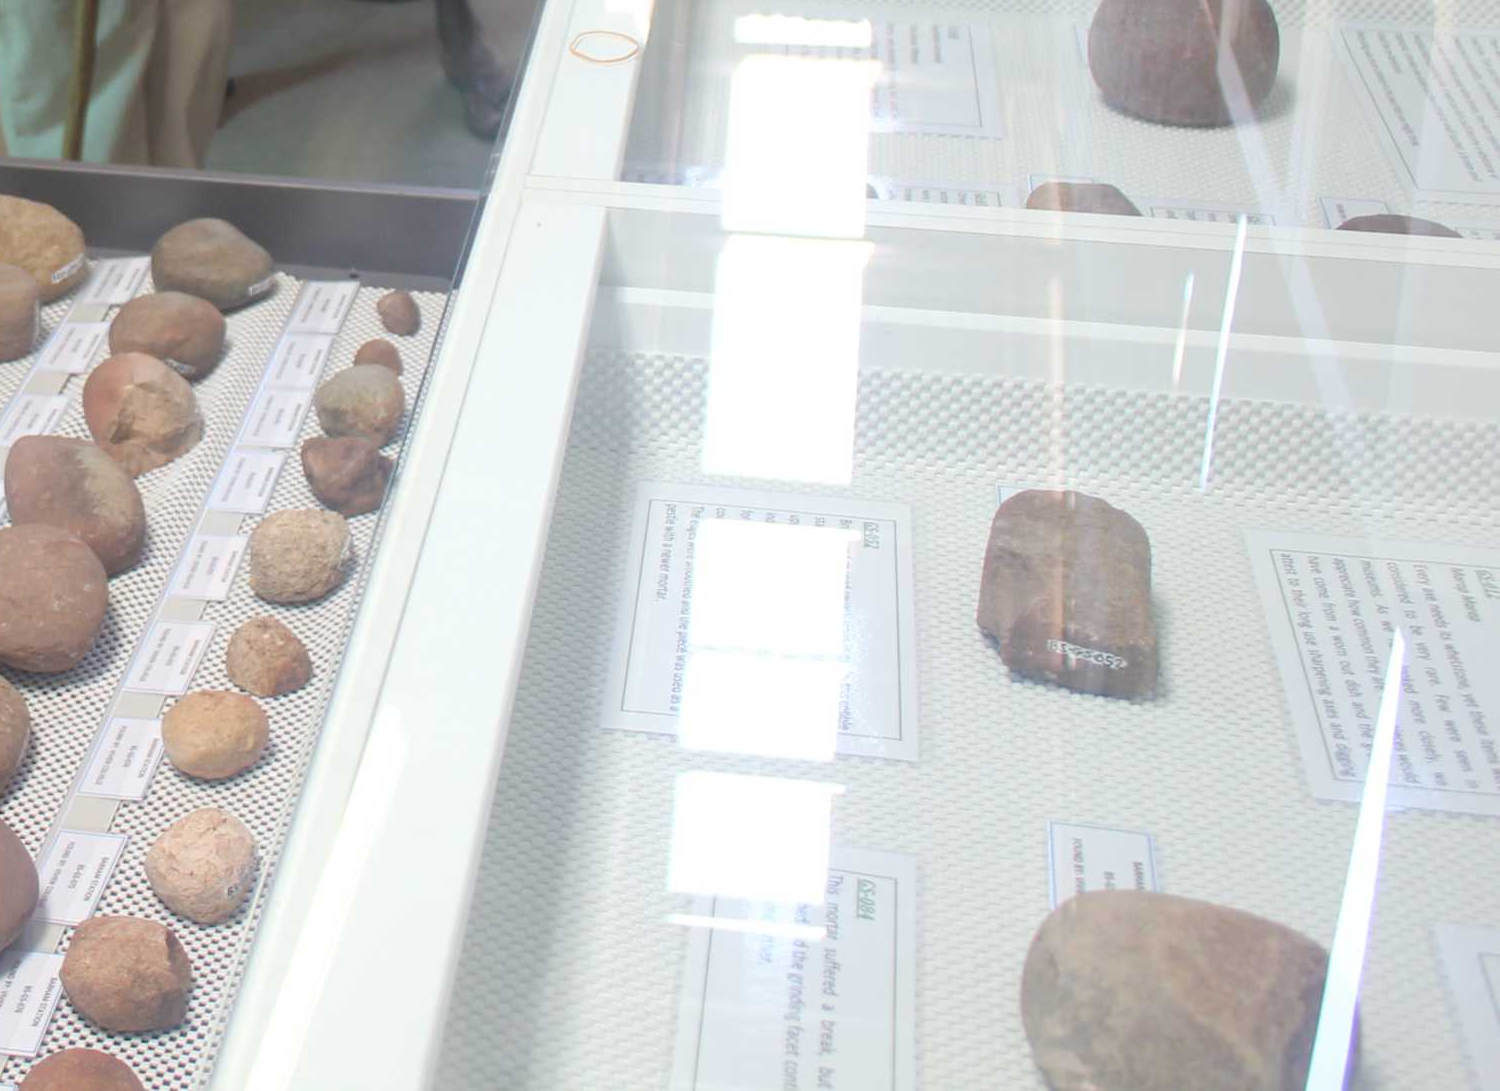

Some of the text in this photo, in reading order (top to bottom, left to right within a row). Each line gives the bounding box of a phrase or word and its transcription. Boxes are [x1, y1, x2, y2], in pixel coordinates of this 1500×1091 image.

[664, 503, 679, 525] pestle
[663, 526, 677, 542] with
[659, 548, 672, 572] newer
[1281, 553, 1298, 575] attest
[1308, 556, 1322, 573] have
[1288, 578, 1300, 586] to
[1314, 576, 1329, 598] come
[1334, 559, 1355, 596] appreciate
[1389, 563, 1412, 603] considered
[1290, 588, 1308, 607] their
[1348, 599, 1362, 616] how
[1295, 610, 1313, 628] long
[1322, 602, 1340, 621] from
[1404, 609, 1417, 619] to
[1303, 630, 1317, 645] use
[1354, 618, 1373, 653] common
[1410, 625, 1425, 635] be
[675, 631, 689, 653] piece
[1330, 634, 1346, 655] worn
[1414, 641, 1430, 660] very
[674, 655, 686, 672] was
[1307, 650, 1332, 695] sharpening
[1339, 660, 1354, 675] out
[1364, 655, 1382, 674] they
[1376, 604, 1389, 614] As
[1408, 700, 1427, 723] more
[1429, 604, 1448, 628] needs
[1460, 692, 1477, 707] yet
[1470, 711, 1490, 735] these
[1345, 679, 1363, 698] dish
[1352, 701, 1370, 719] and
[1434, 694, 1452, 712] Few
[1329, 722, 1347, 740] and
[1358, 723, 1374, 737] the
[1443, 719, 1461, 742] were
[1398, 755, 1416, 782] would
[1454, 749, 1472, 771] seen
[60, 841, 76, 858] FOUND
[83, 857, 108, 900] BARHAM STATION
[828, 872, 843, 896] This
[825, 902, 839, 939] mortar
[791, 950, 808, 969] the
[822, 949, 841, 995] suffered
[31, 978, 57, 1027] BARHAM STATION
[785, 973, 805, 1020] grinding
[786, 1026, 803, 1054] facet
[818, 1020, 837, 1055] break,
[817, 1066, 836, 1089] but
